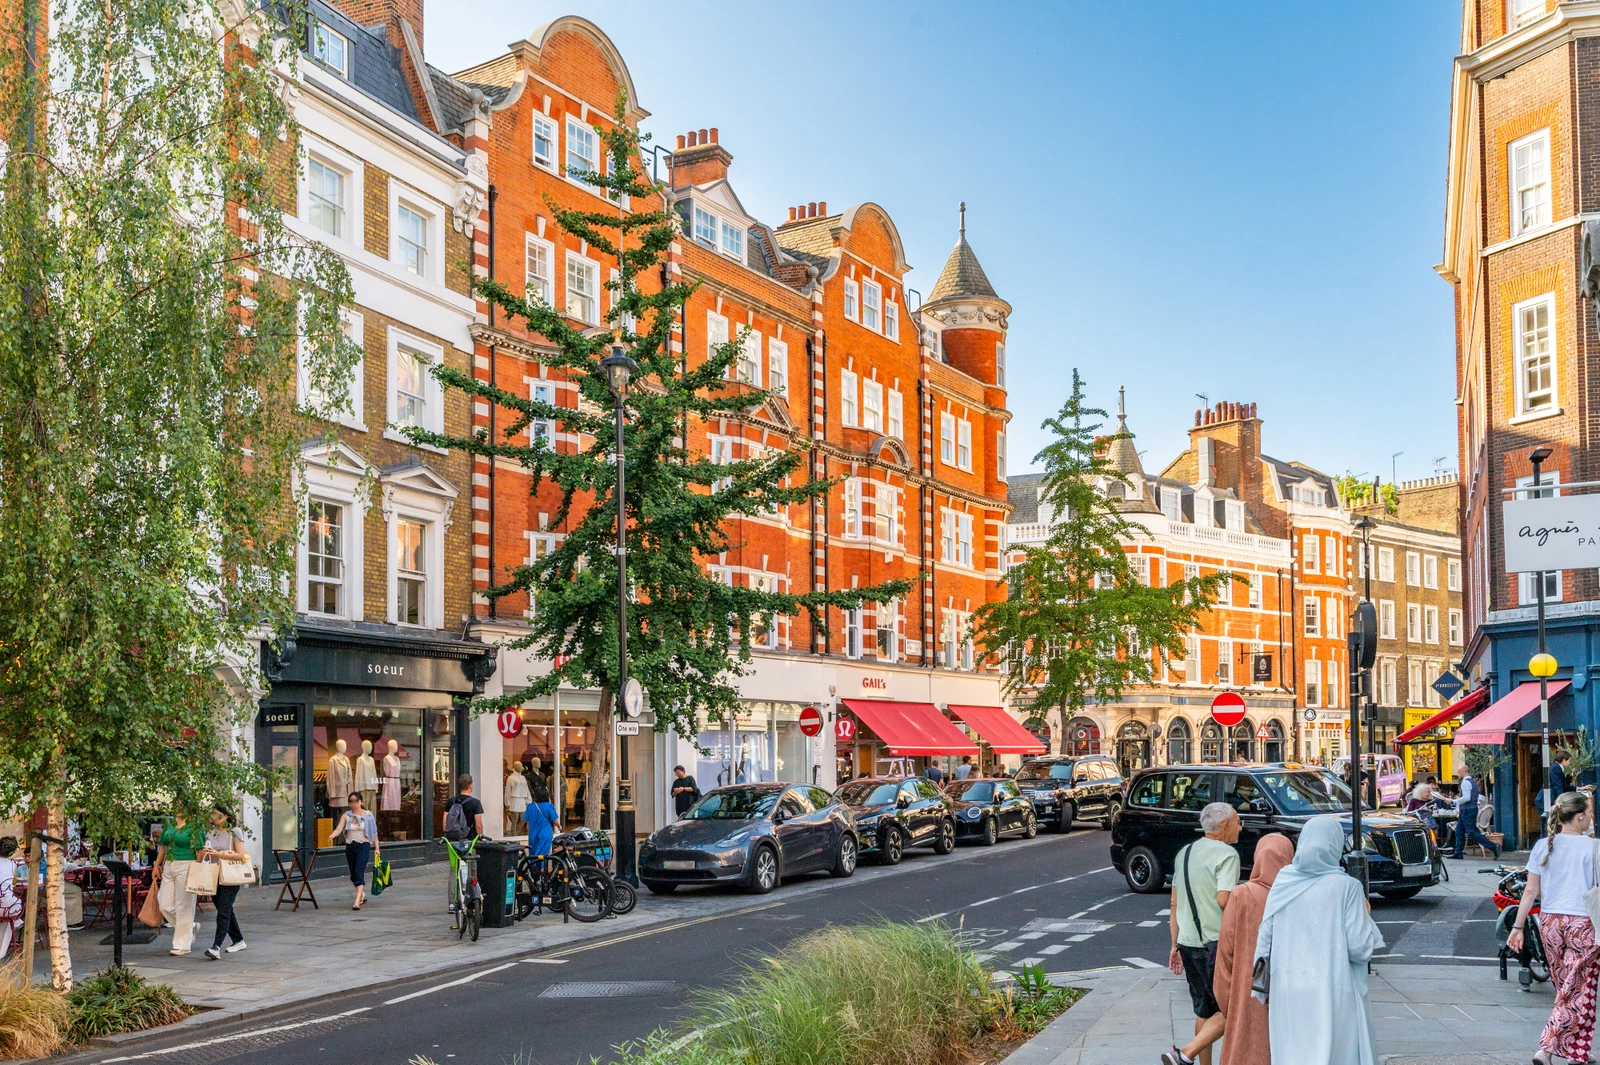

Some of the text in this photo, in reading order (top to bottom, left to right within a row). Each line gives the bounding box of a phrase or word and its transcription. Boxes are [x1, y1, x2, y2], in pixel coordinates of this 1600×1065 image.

[1518, 520, 1579, 547] agnès
[1578, 537, 1600, 546] PA
[367, 663, 404, 676] soeur
[862, 677, 886, 689] GAIL's
[265, 713, 295, 722] soeur
